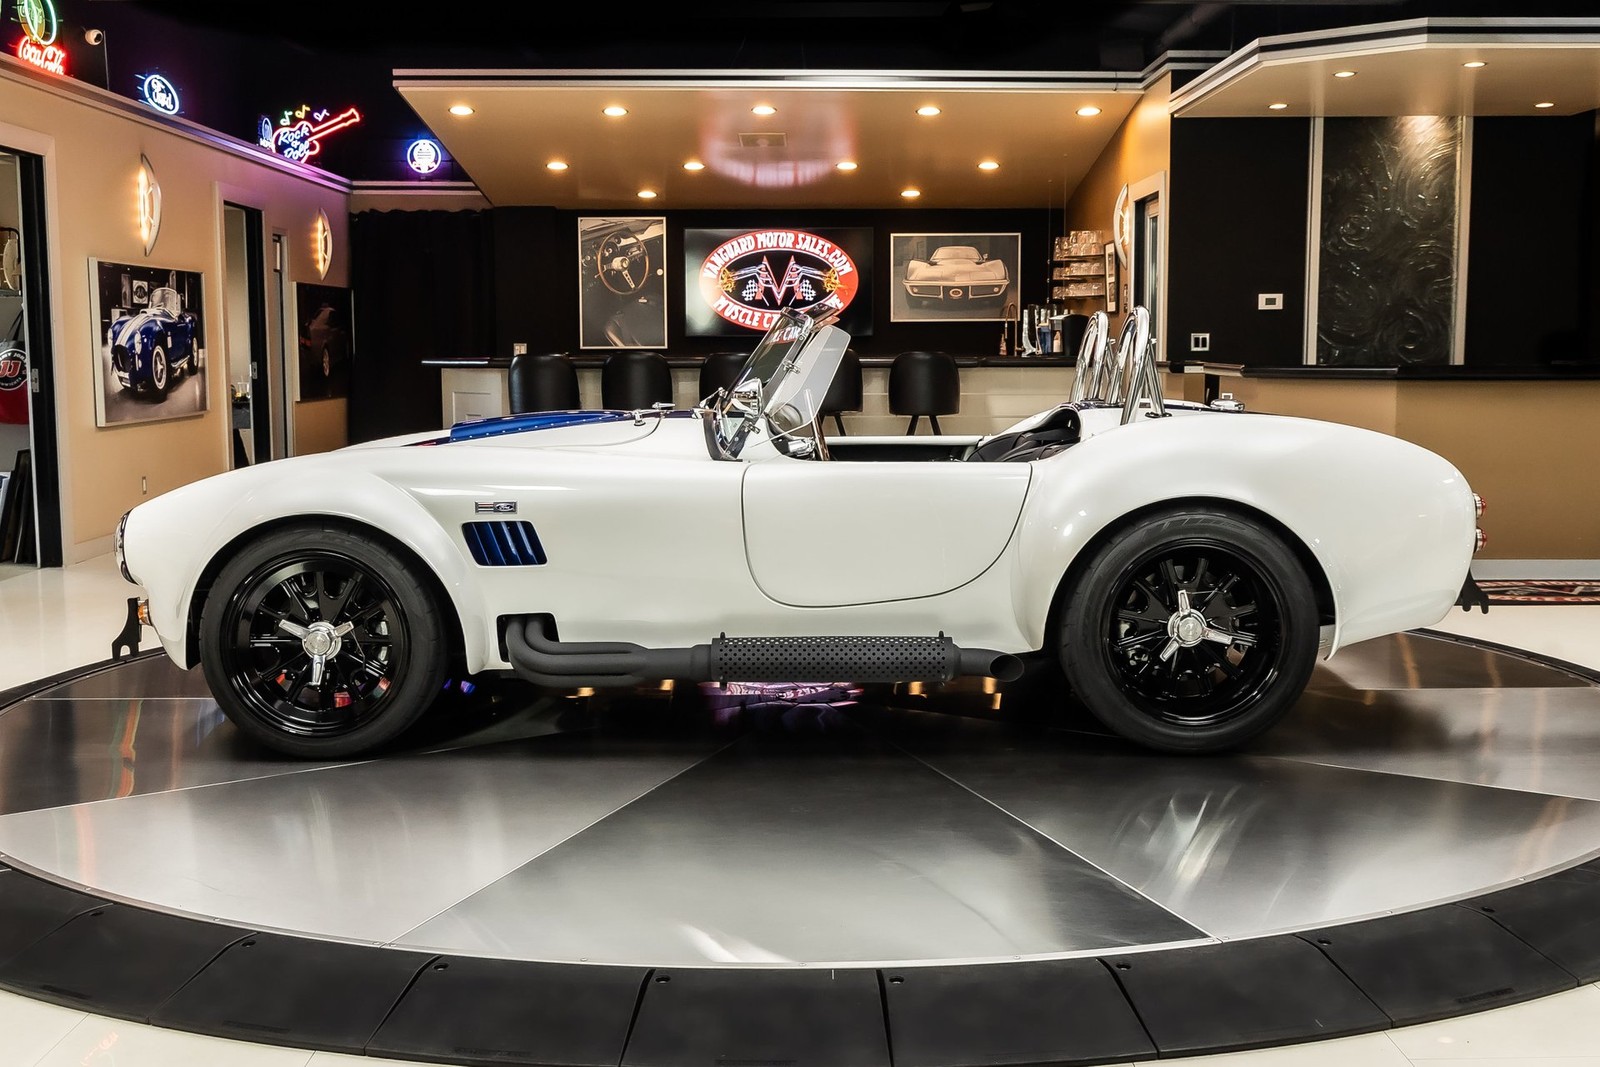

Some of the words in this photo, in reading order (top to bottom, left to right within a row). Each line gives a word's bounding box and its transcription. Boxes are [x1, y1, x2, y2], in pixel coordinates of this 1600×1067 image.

[151, 78, 174, 110] Ford
[278, 124, 310, 145] Rock
[703, 235, 755, 279] VANGUARD
[755, 231, 796, 250] MOTOR
[796, 233, 853, 277] SALES.COM
[713, 295, 764, 327] MUSCLE
